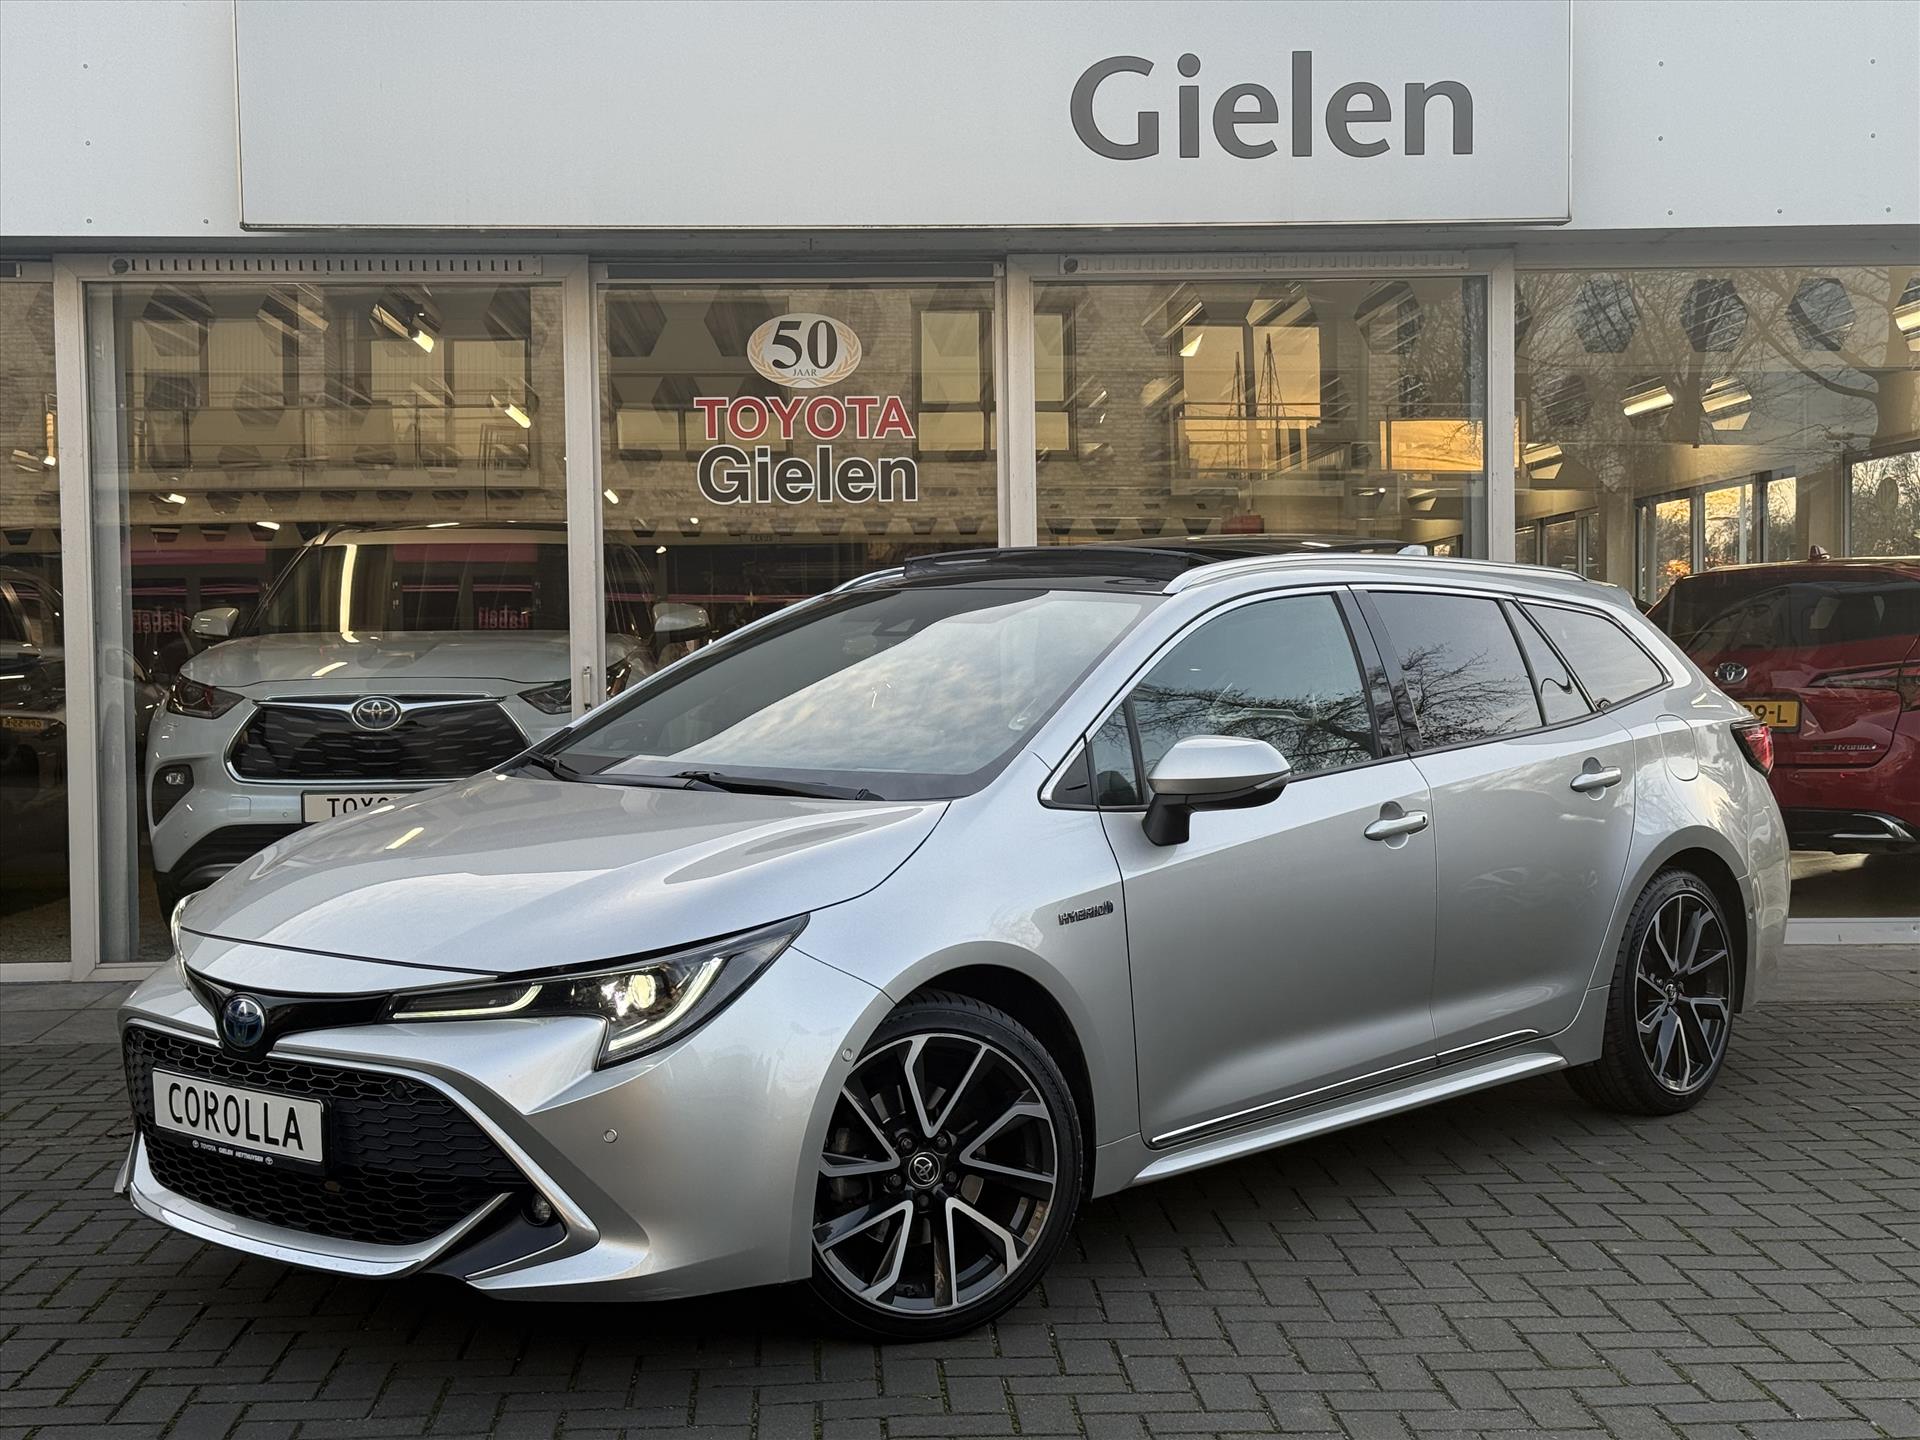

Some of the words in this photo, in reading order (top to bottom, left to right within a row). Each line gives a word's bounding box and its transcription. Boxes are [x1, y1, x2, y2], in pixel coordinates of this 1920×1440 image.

[1070, 51, 1474, 161] Gielen
[772, 320, 838, 370] 50
[793, 369, 818, 377] JAAR
[693, 396, 917, 440] TOYOTA
[697, 444, 919, 505] Gielen
[1058, 904, 1105, 926] HYBRID
[169, 1082, 304, 1151] COROLLA
[200, 1143, 216, 1152] TOYOTA
